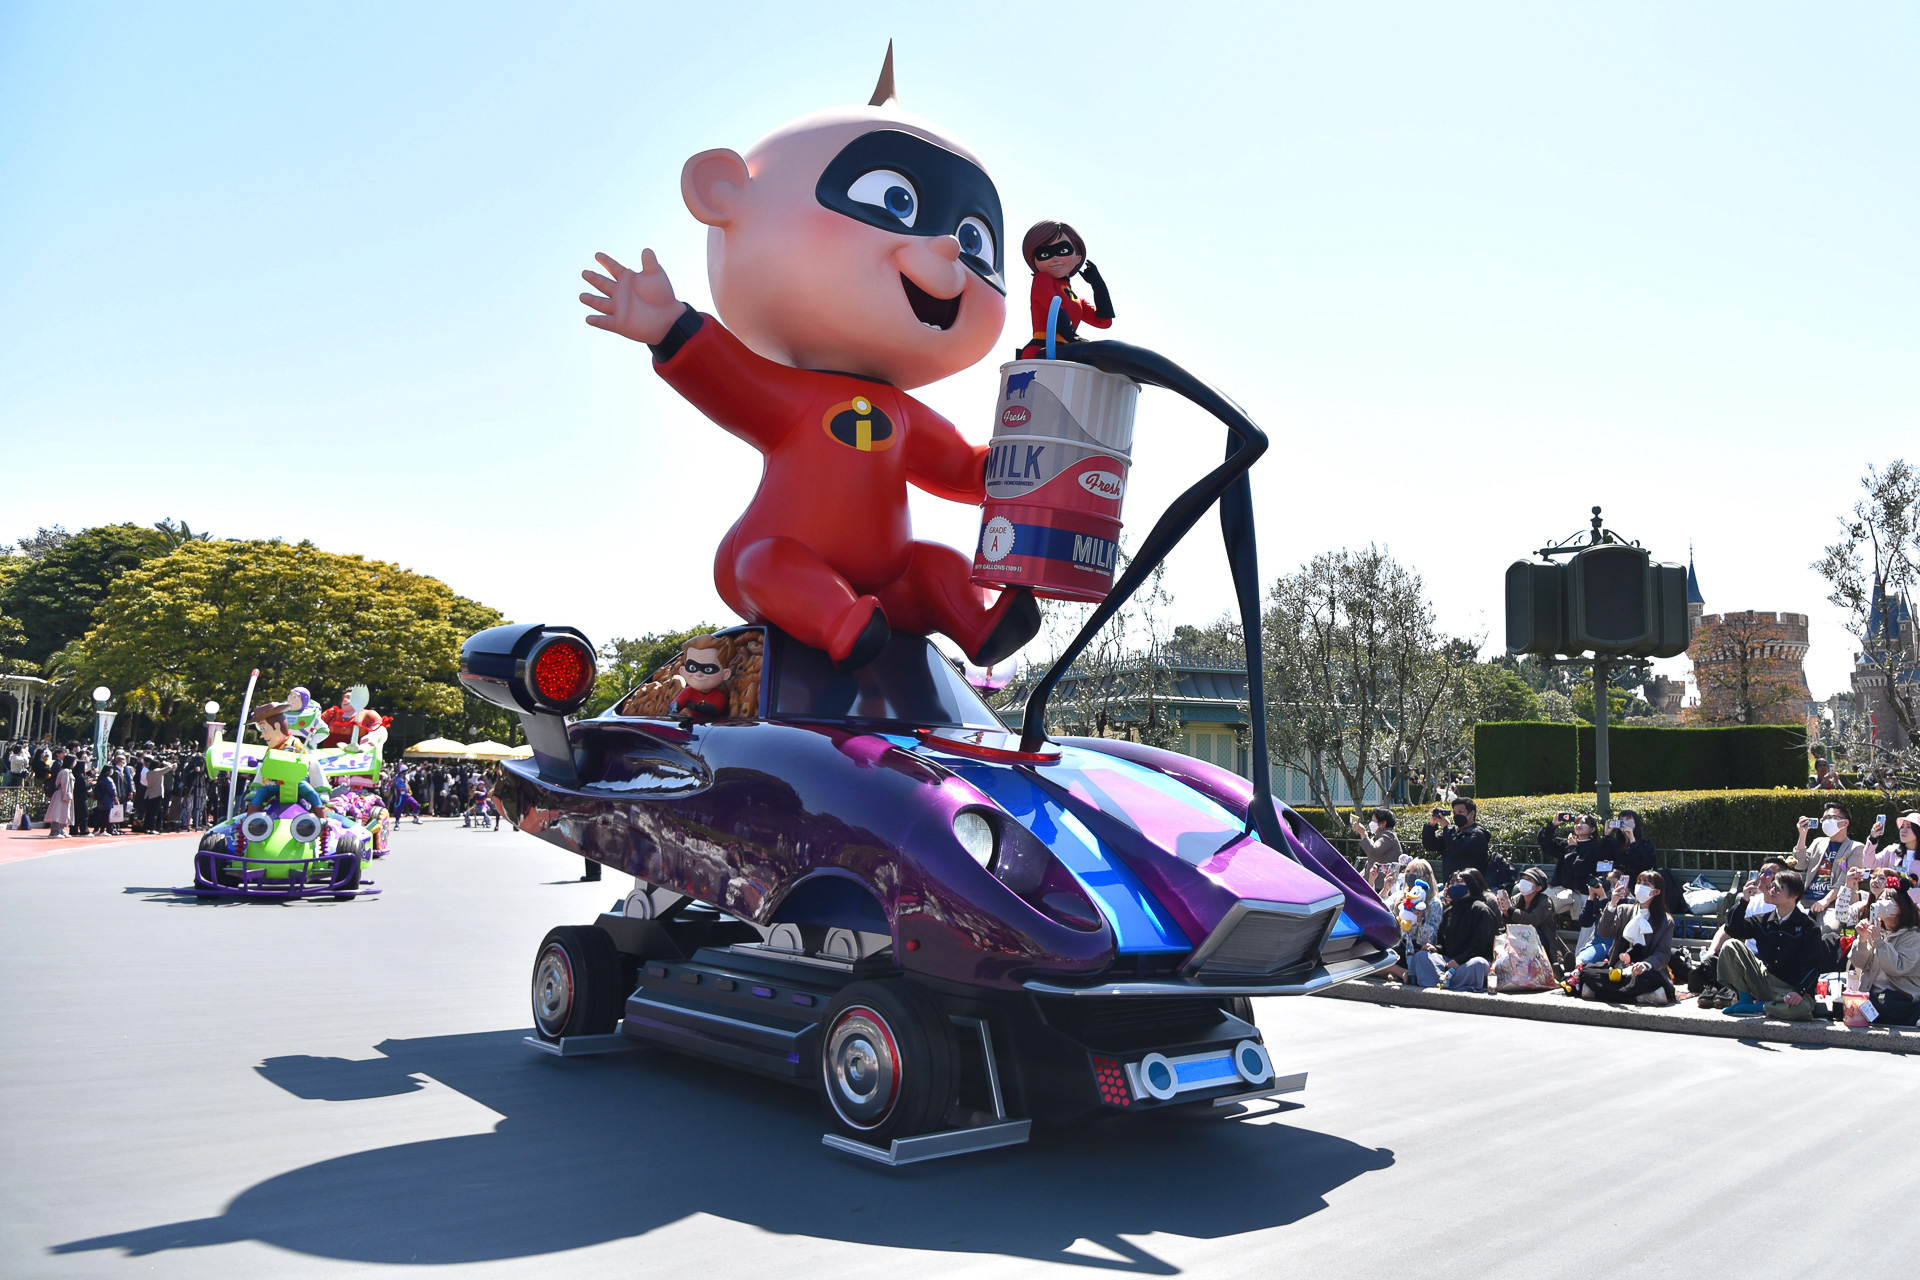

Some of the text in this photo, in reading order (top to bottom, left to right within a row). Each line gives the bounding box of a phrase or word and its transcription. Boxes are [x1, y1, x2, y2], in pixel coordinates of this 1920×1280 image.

[1004, 410, 1026, 422] Fresh
[987, 444, 1045, 480] MILK
[1085, 473, 1120, 496] Fresh
[989, 526, 1007, 534] GRADE
[990, 535, 998, 552] A
[1073, 535, 1115, 569] MILK
